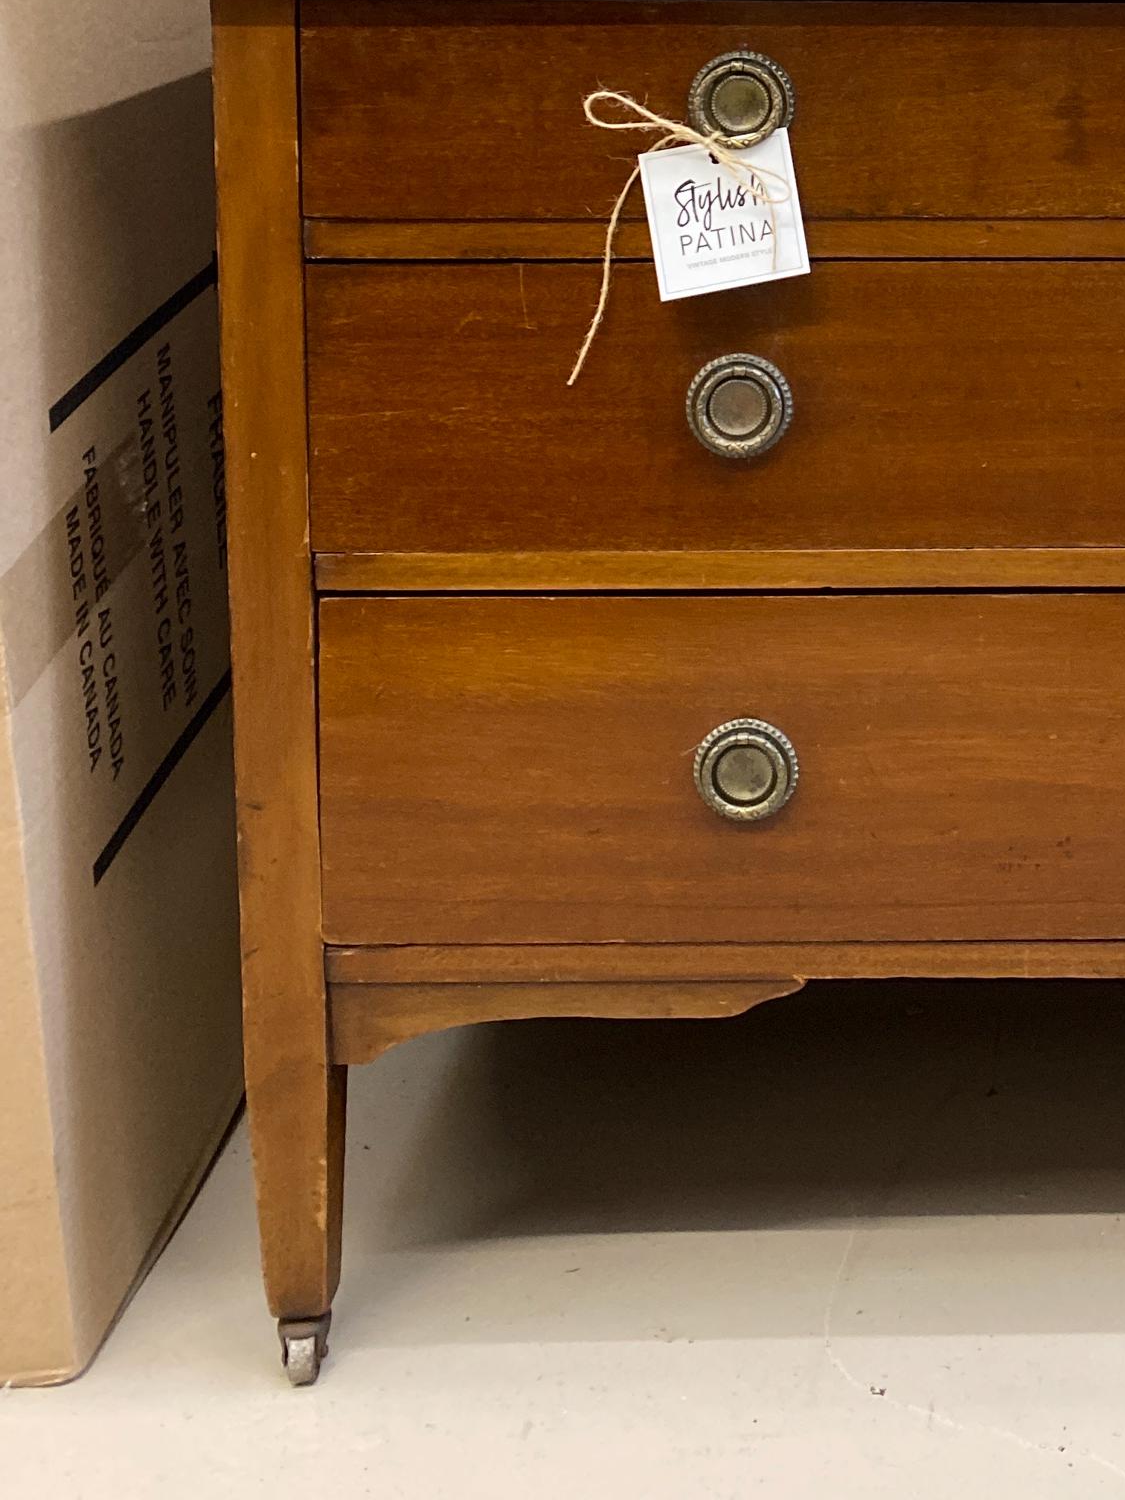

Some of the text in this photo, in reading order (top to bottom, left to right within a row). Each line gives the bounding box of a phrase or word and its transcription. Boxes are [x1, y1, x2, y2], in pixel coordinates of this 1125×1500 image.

[680, 219, 774, 256] PATINA
[136, 387, 177, 712] HANDLE WITH CARE
[156, 341, 198, 707] MANIPULER AVEC SOIN
[66, 505, 102, 774] MADE IN CANADA
[97, 607, 113, 649] AU
[103, 653, 125, 781] CANADA
